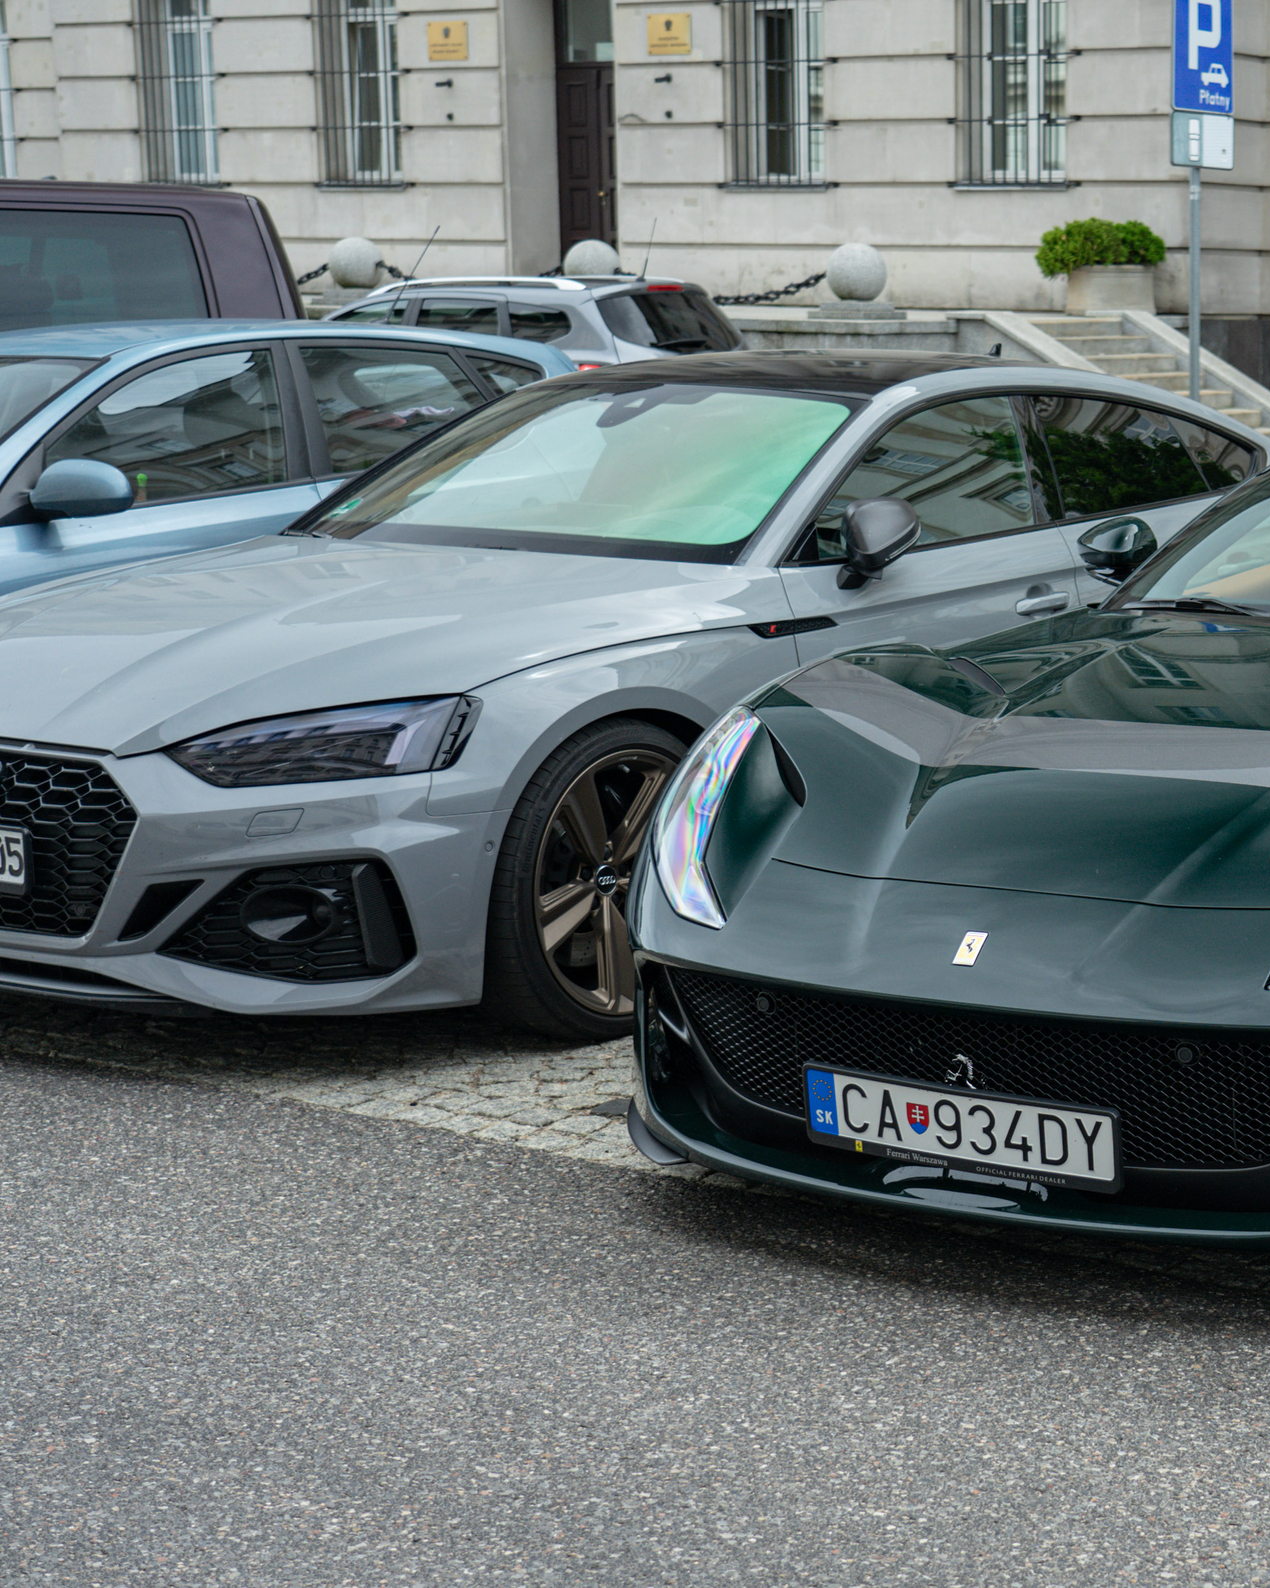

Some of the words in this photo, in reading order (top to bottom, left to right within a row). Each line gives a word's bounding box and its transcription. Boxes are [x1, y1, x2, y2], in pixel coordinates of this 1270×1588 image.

[1188, 0, 1221, 70] P
[1199, 89, 1231, 111] Płatny
[816, 1109, 834, 1125] SK
[886, 1148, 911, 1160] Ferrari
[912, 1152, 948, 1167] Warszawa
[976, 1166, 1008, 1177] OFFICIAL
[1008, 1171, 1038, 1181] FERRARI
[1039, 1176, 1067, 1185] DEALER
